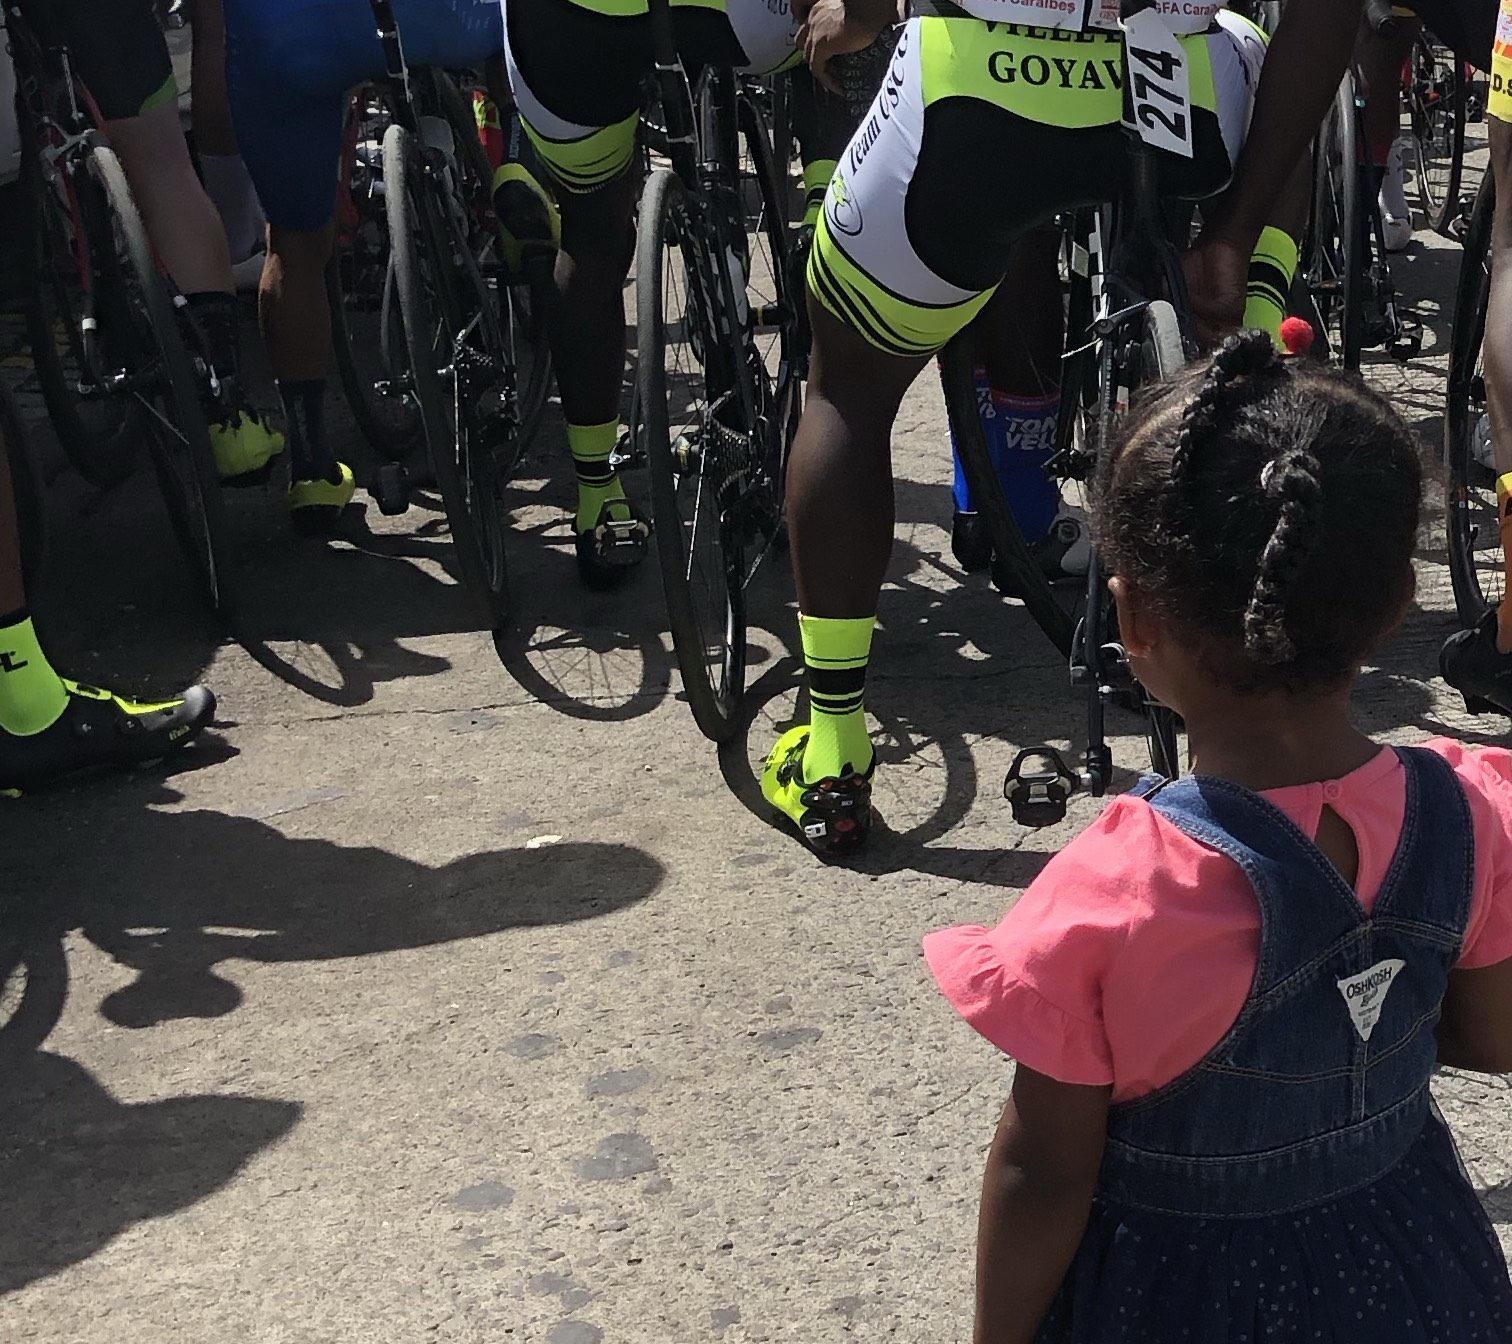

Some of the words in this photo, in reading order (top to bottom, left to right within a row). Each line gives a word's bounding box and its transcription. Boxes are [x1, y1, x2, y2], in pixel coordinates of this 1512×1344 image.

[1129, 45, 1188, 142] 274
[849, 112, 882, 176] Team
[1346, 966, 1393, 999] OSHKOSH
